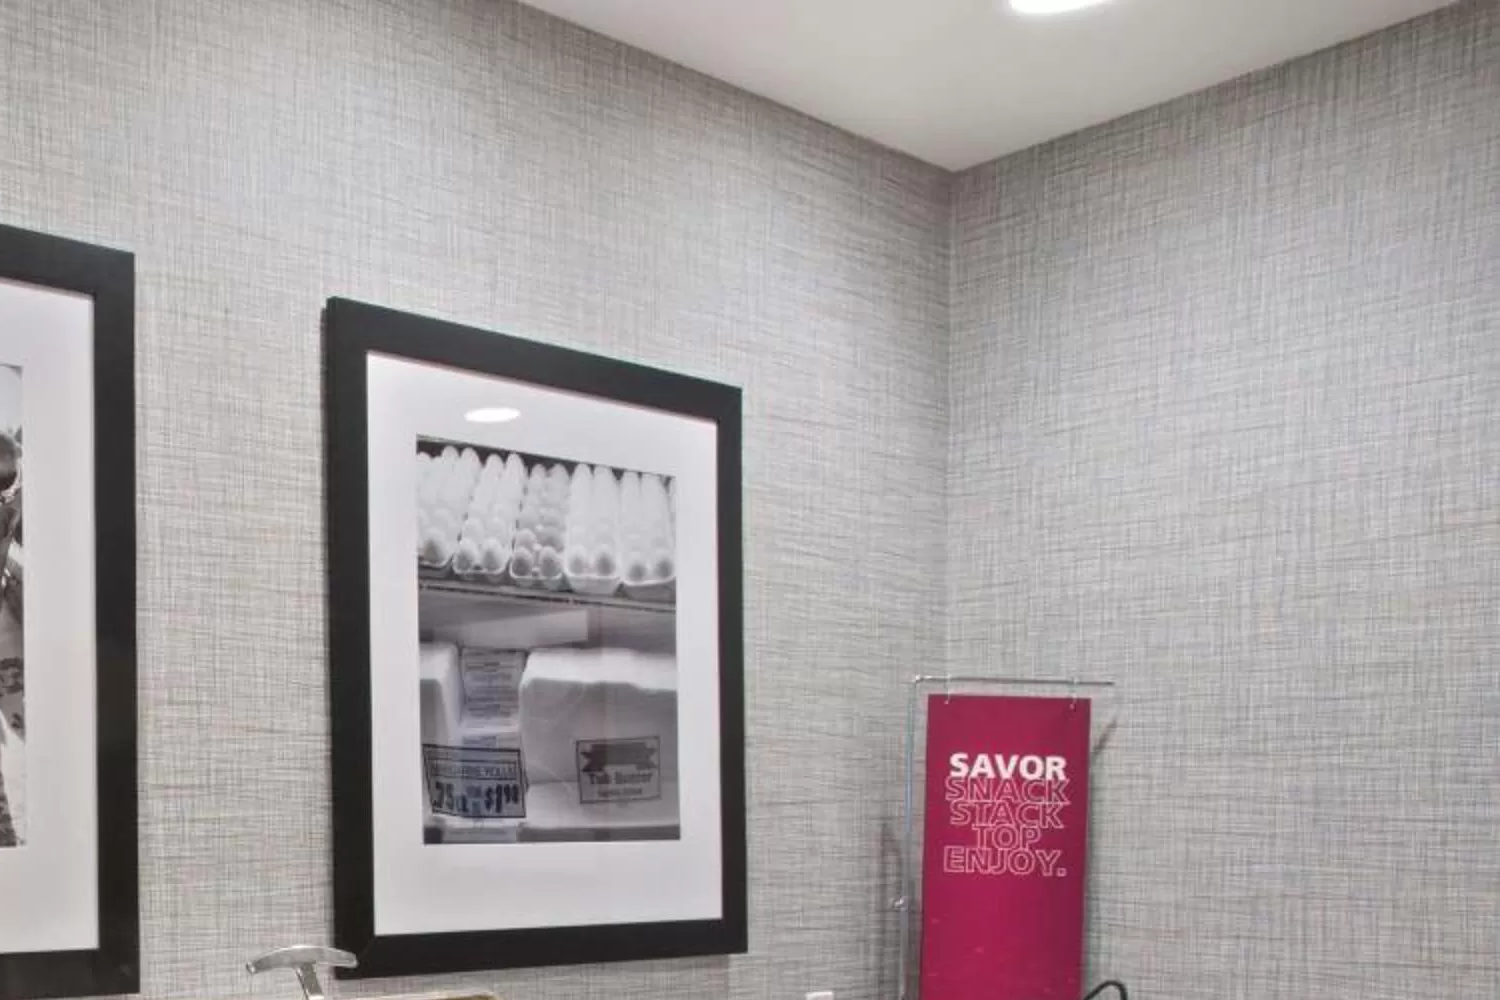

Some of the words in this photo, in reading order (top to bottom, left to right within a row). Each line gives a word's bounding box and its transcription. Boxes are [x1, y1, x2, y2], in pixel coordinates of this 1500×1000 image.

[949, 752, 1067, 780] SAVOR
[945, 776, 1071, 805] SNACK
[949, 801, 1065, 829] STACK
[972, 824, 1042, 851] TOP
[943, 846, 1068, 877] ENJOY.
